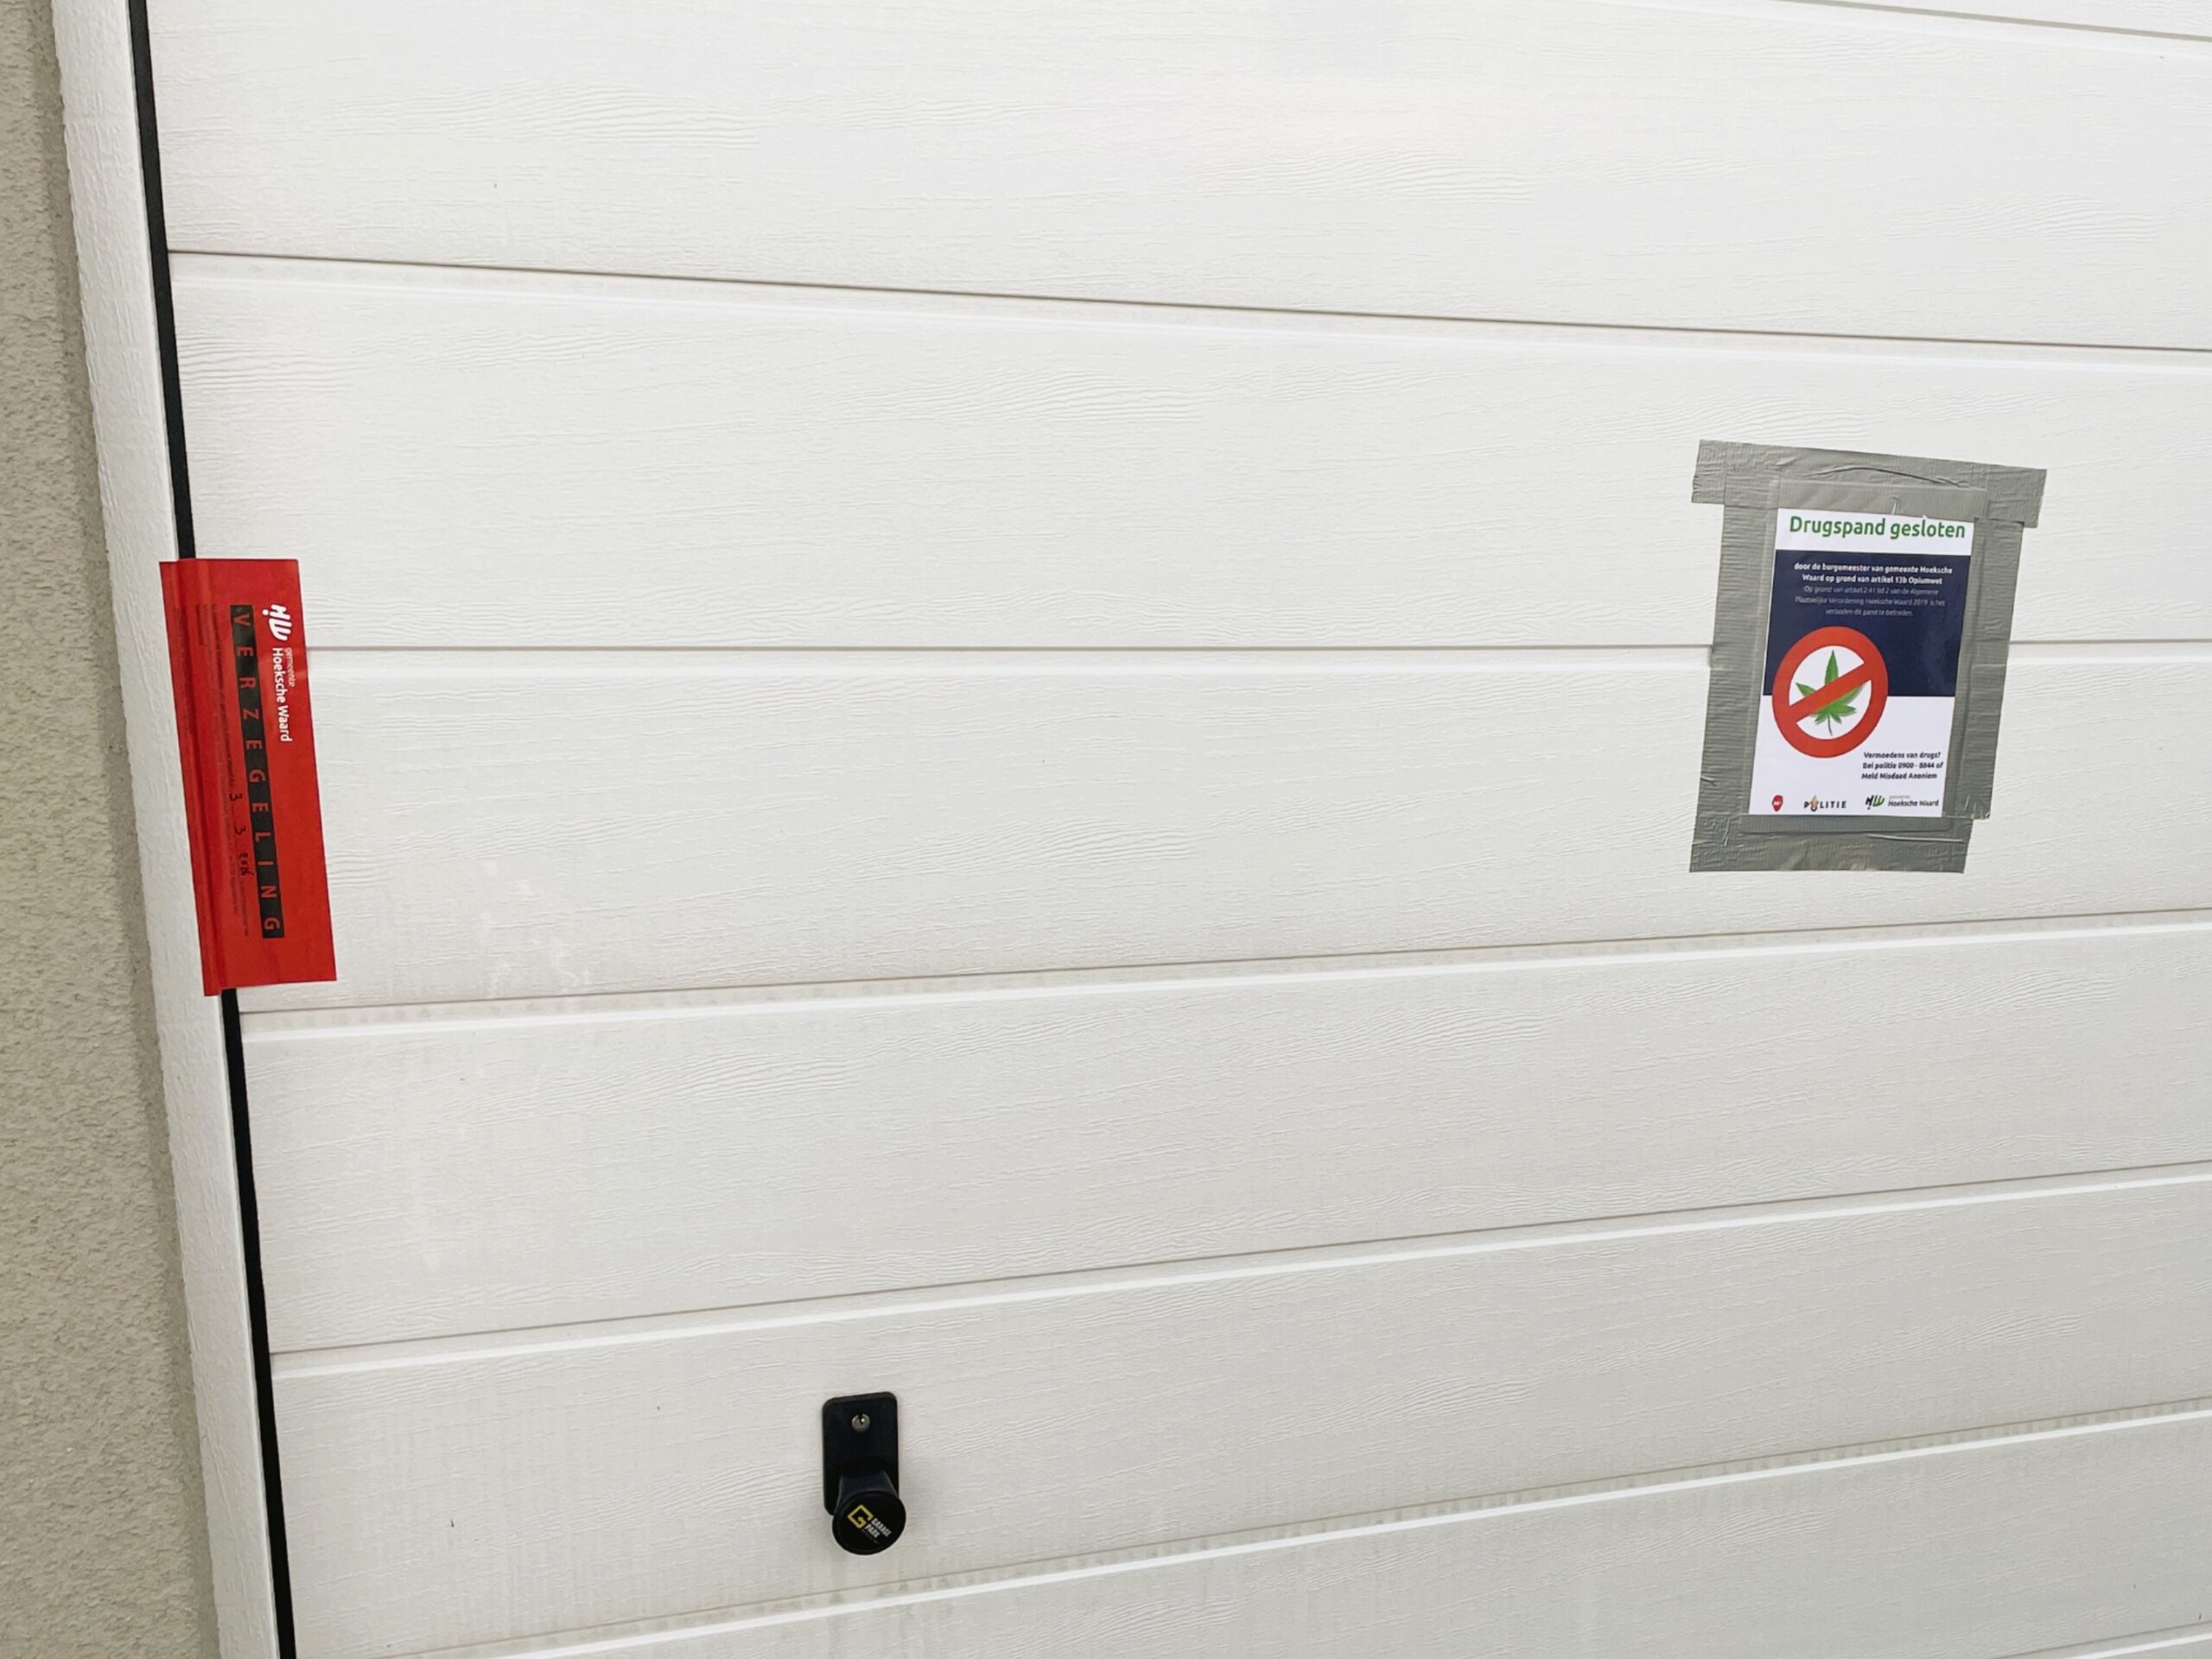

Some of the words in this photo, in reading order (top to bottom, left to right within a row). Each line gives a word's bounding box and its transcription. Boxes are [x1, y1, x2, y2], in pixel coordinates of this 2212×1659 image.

[1789, 515, 1886, 538] Drugspand
[1891, 521, 1966, 540] gesloten
[1822, 563, 1870, 572] burgemeester
[1920, 566, 1953, 575] Hoeksche
[1836, 575, 1856, 583] grond
[1871, 575, 1893, 584] artikel
[1909, 576, 1942, 585] Opiumwet
[1804, 585, 1813, 594] Op
[272, 648, 289, 703] Hoeksche
[277, 705, 293, 742] Waard
[233, 613, 280, 931] VERZEGELING
